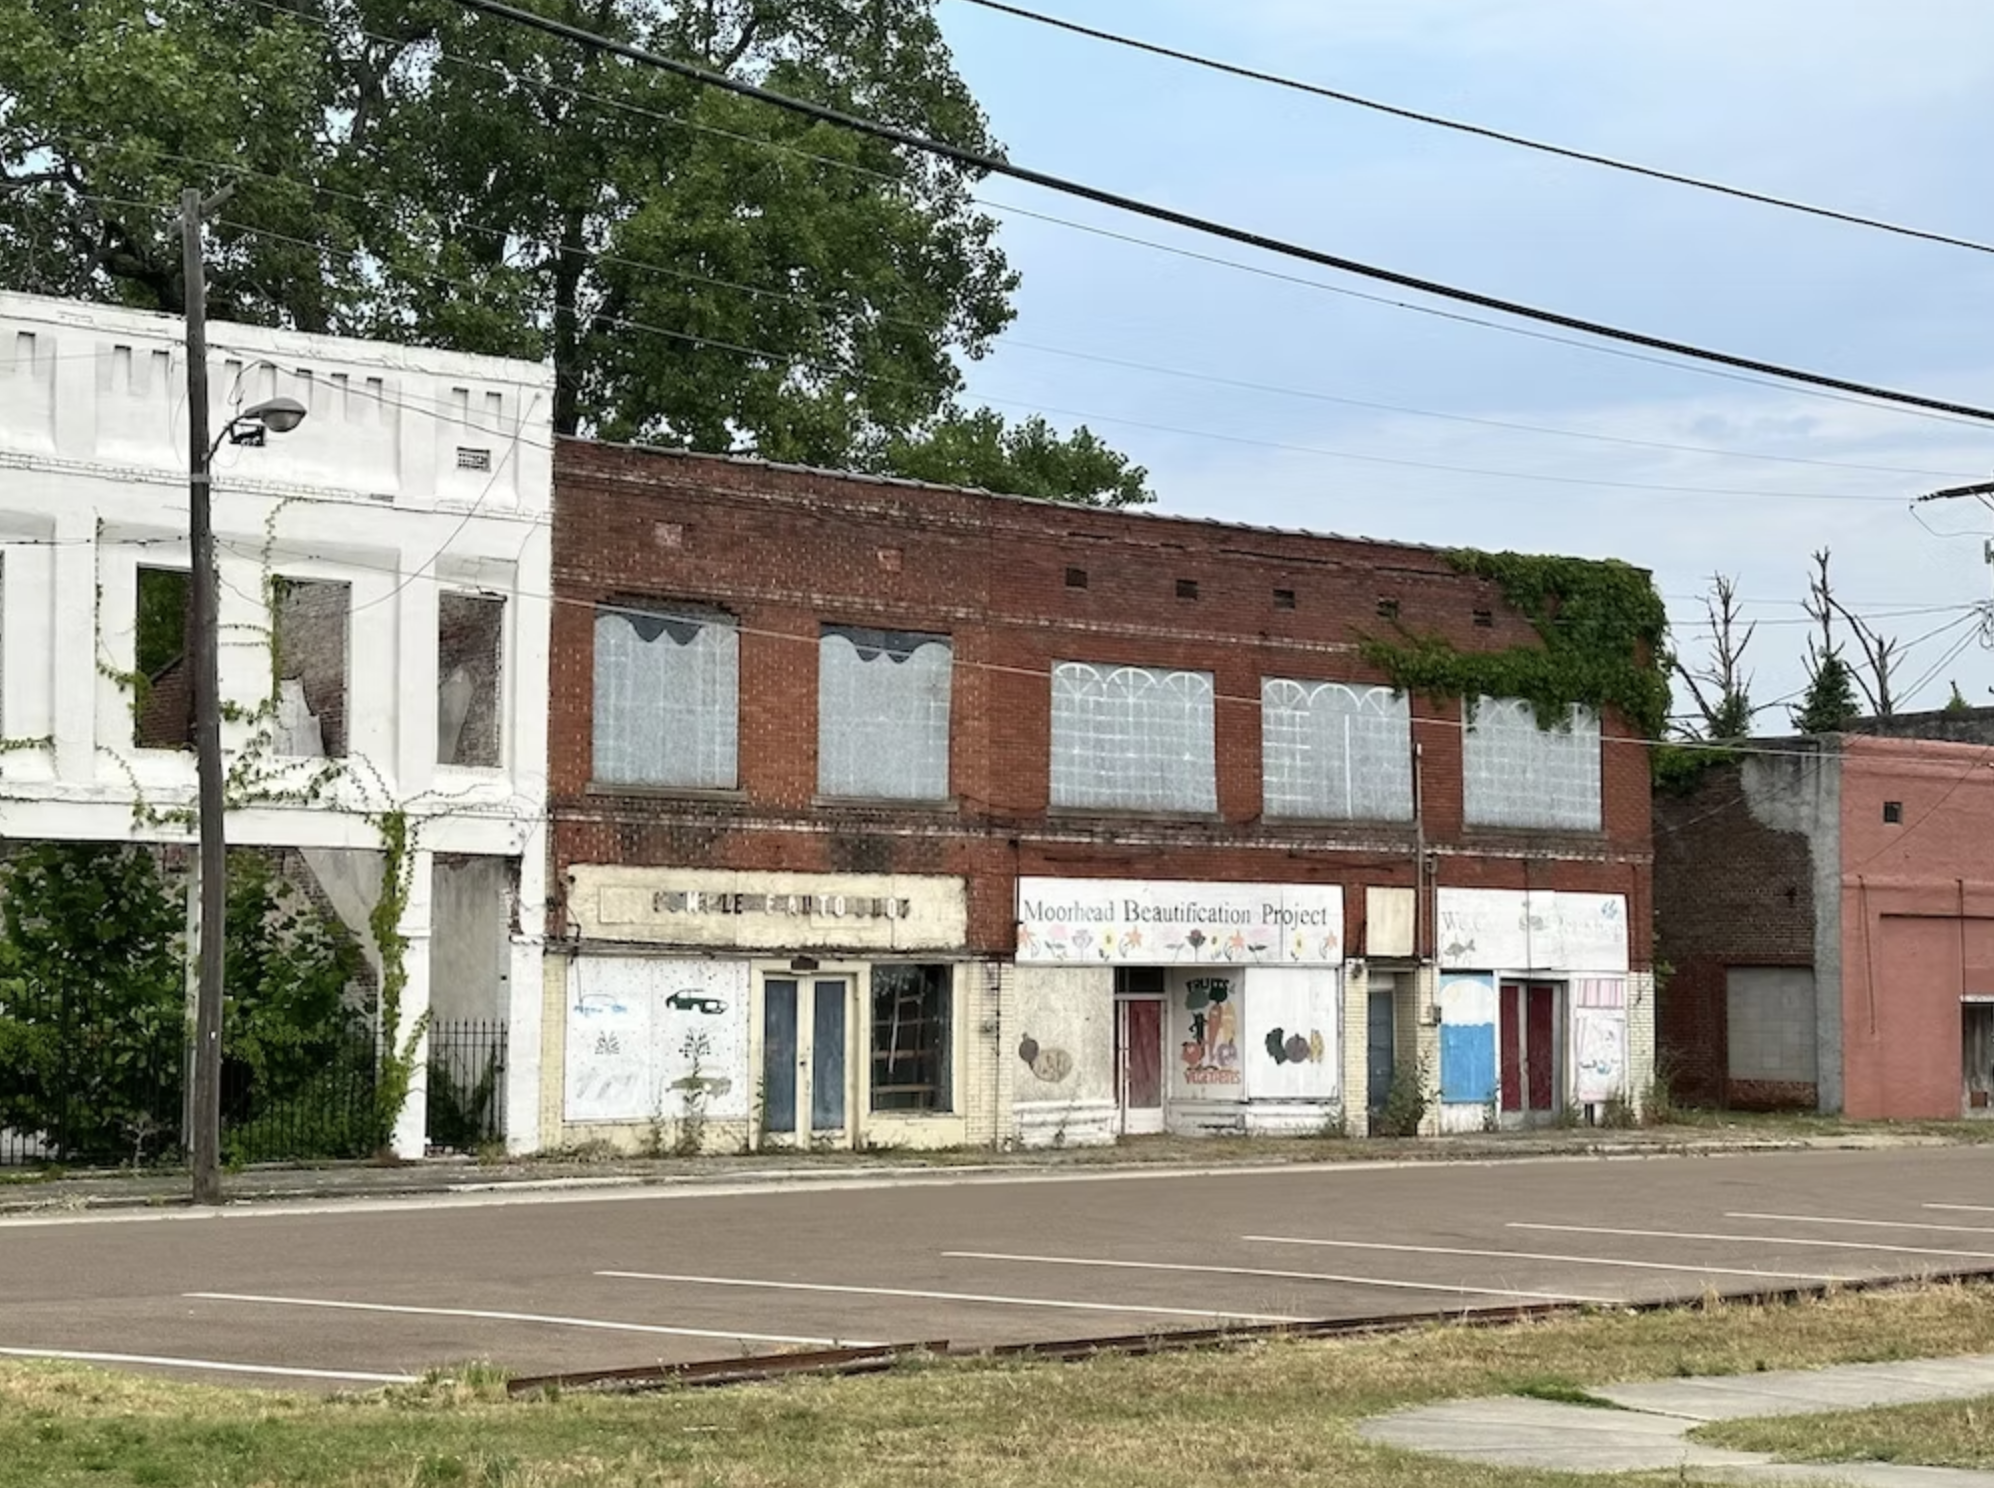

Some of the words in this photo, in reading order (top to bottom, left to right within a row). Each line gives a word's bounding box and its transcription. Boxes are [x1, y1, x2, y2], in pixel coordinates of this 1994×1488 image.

[1024, 899, 1114, 923] Moorhead
[1123, 899, 1250, 924] Beautification
[1262, 903, 1327, 930] Project
